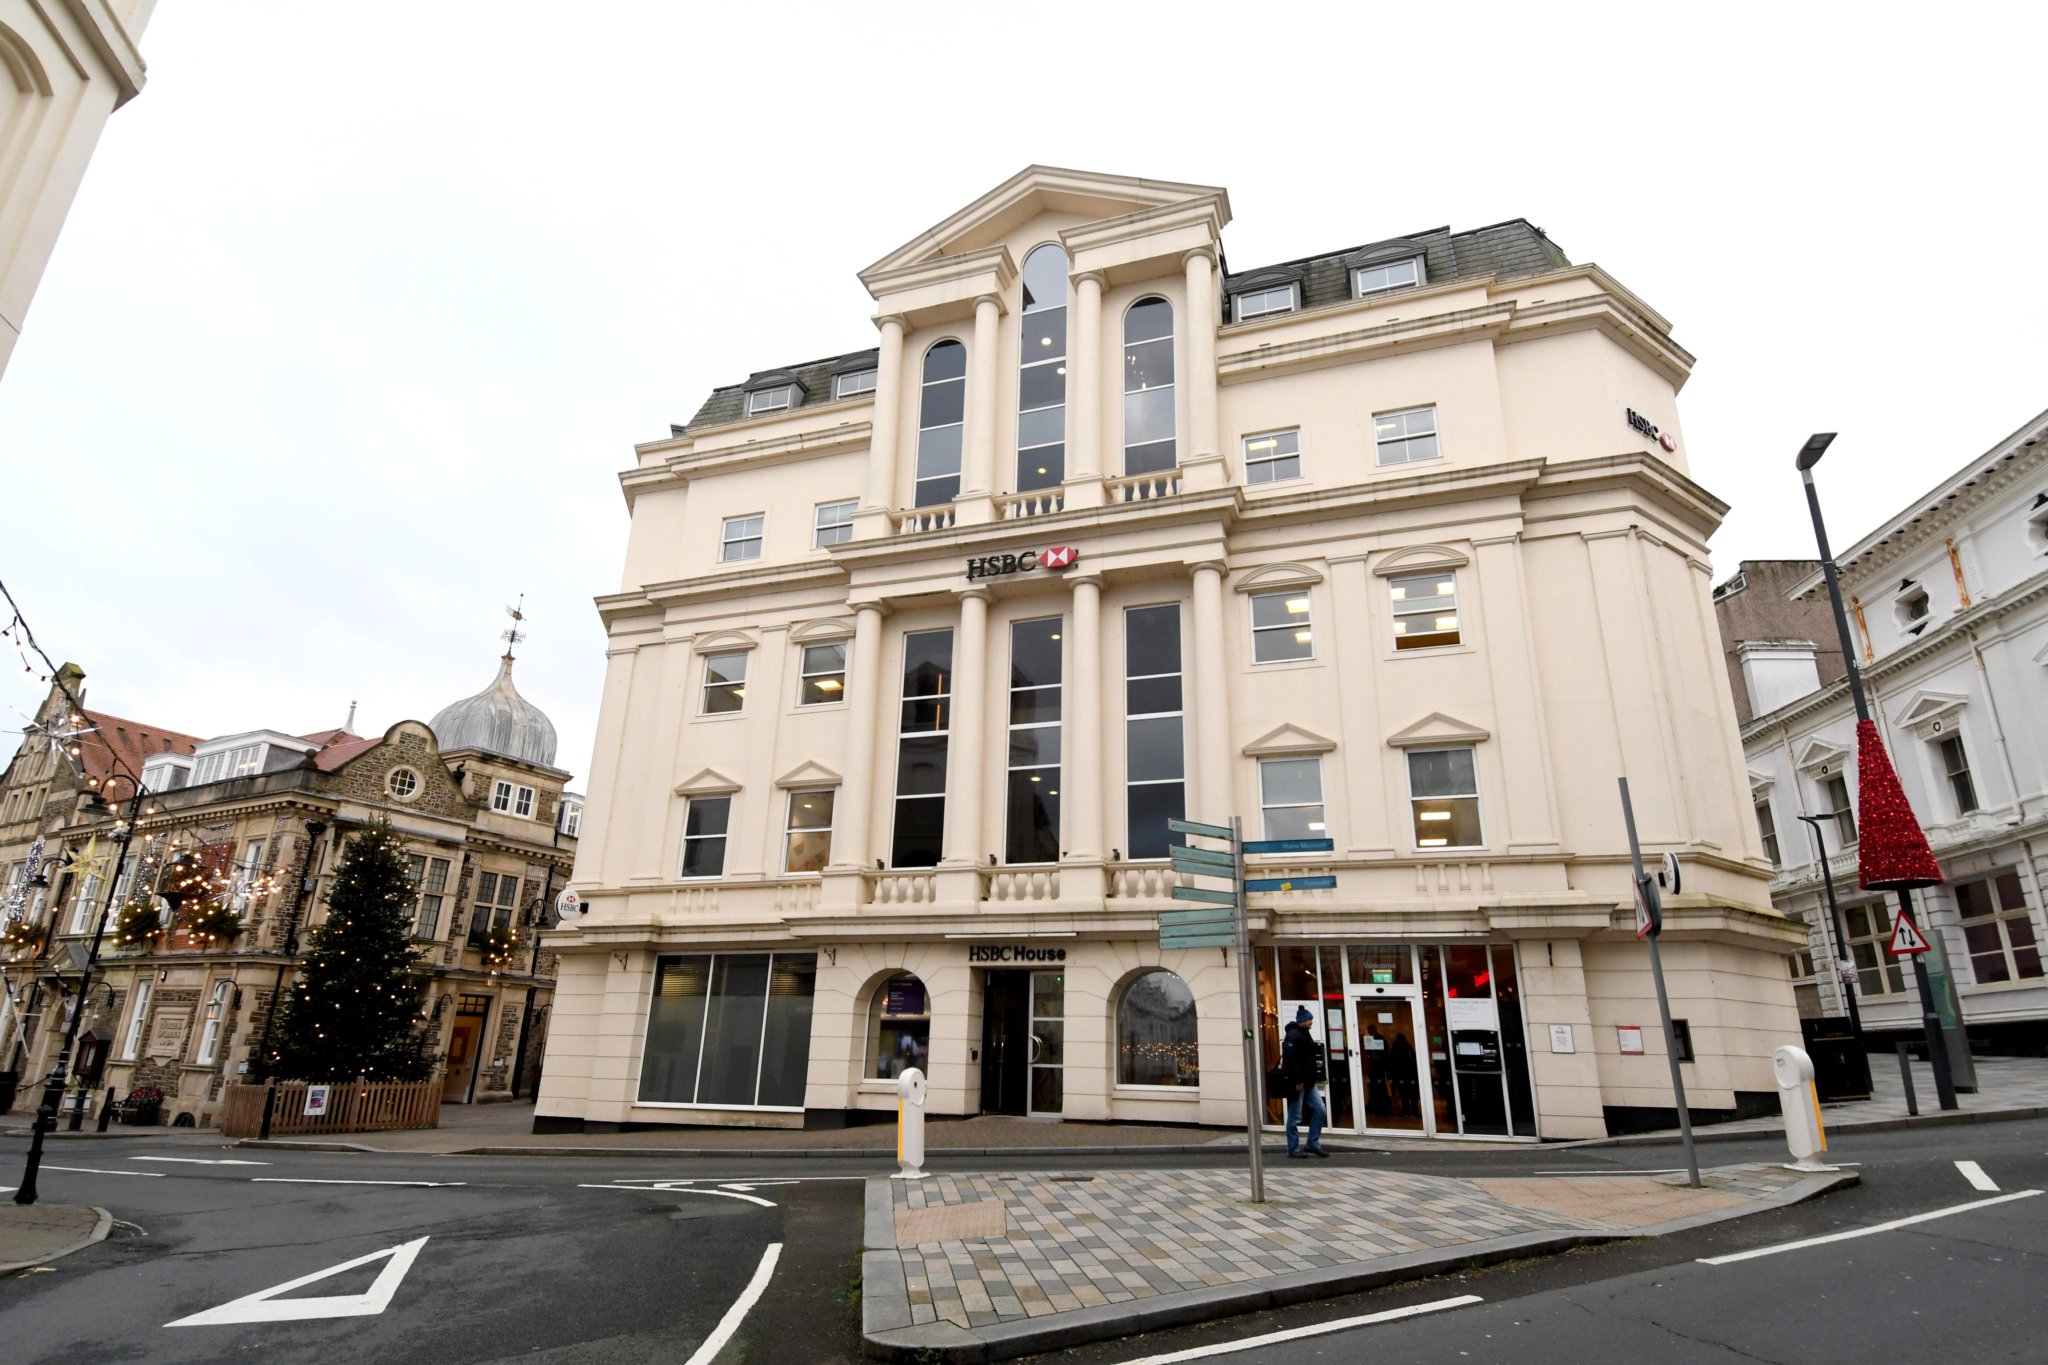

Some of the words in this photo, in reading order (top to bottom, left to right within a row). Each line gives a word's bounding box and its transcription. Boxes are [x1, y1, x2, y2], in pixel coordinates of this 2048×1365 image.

[1626, 408, 1659, 441] HSBC
[966, 551, 1036, 578] HSBC
[560, 902, 579, 912] HSBC
[969, 945, 1011, 962] HSBC
[1013, 945, 1066, 962] House
